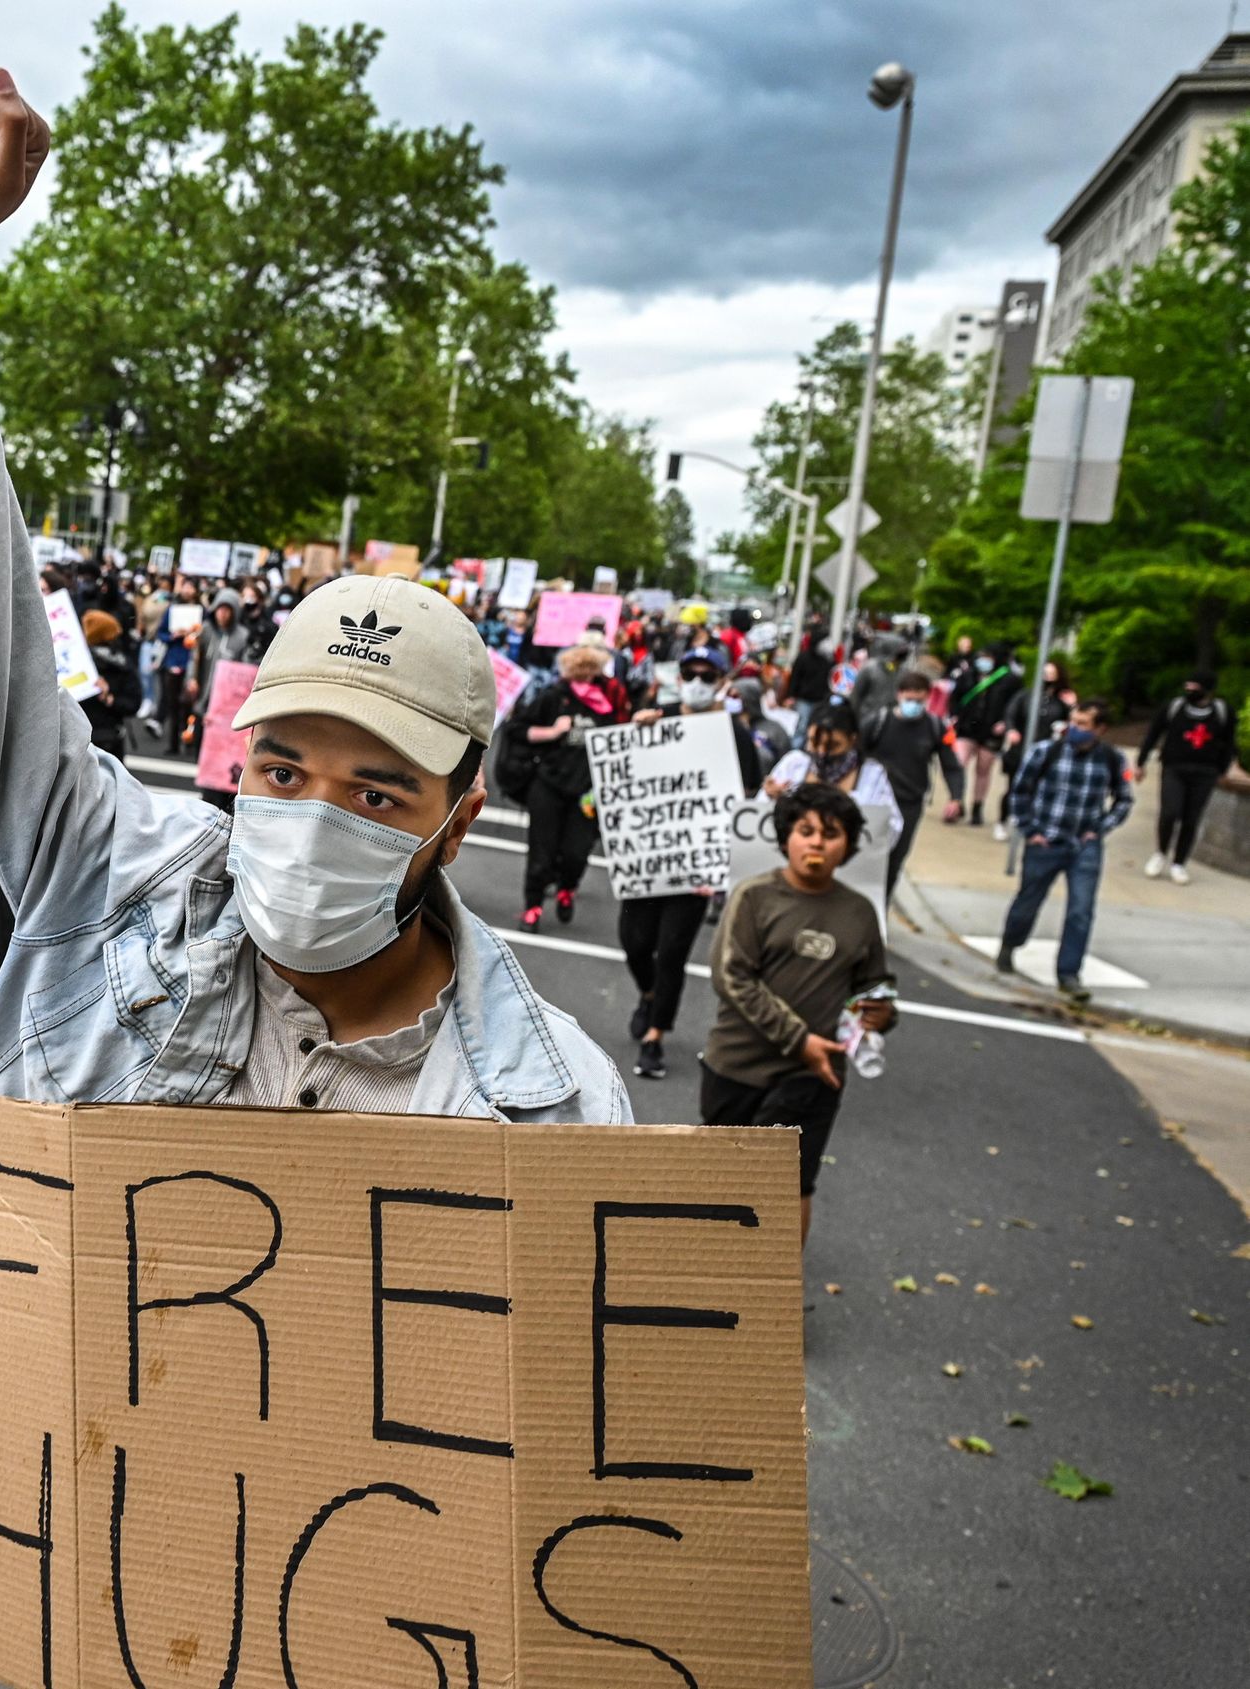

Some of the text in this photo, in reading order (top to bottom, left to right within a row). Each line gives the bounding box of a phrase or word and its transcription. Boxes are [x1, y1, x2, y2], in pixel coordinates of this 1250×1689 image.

[327, 642, 391, 666] adidas
[595, 756, 633, 783] THE
[605, 808, 623, 832] OF
